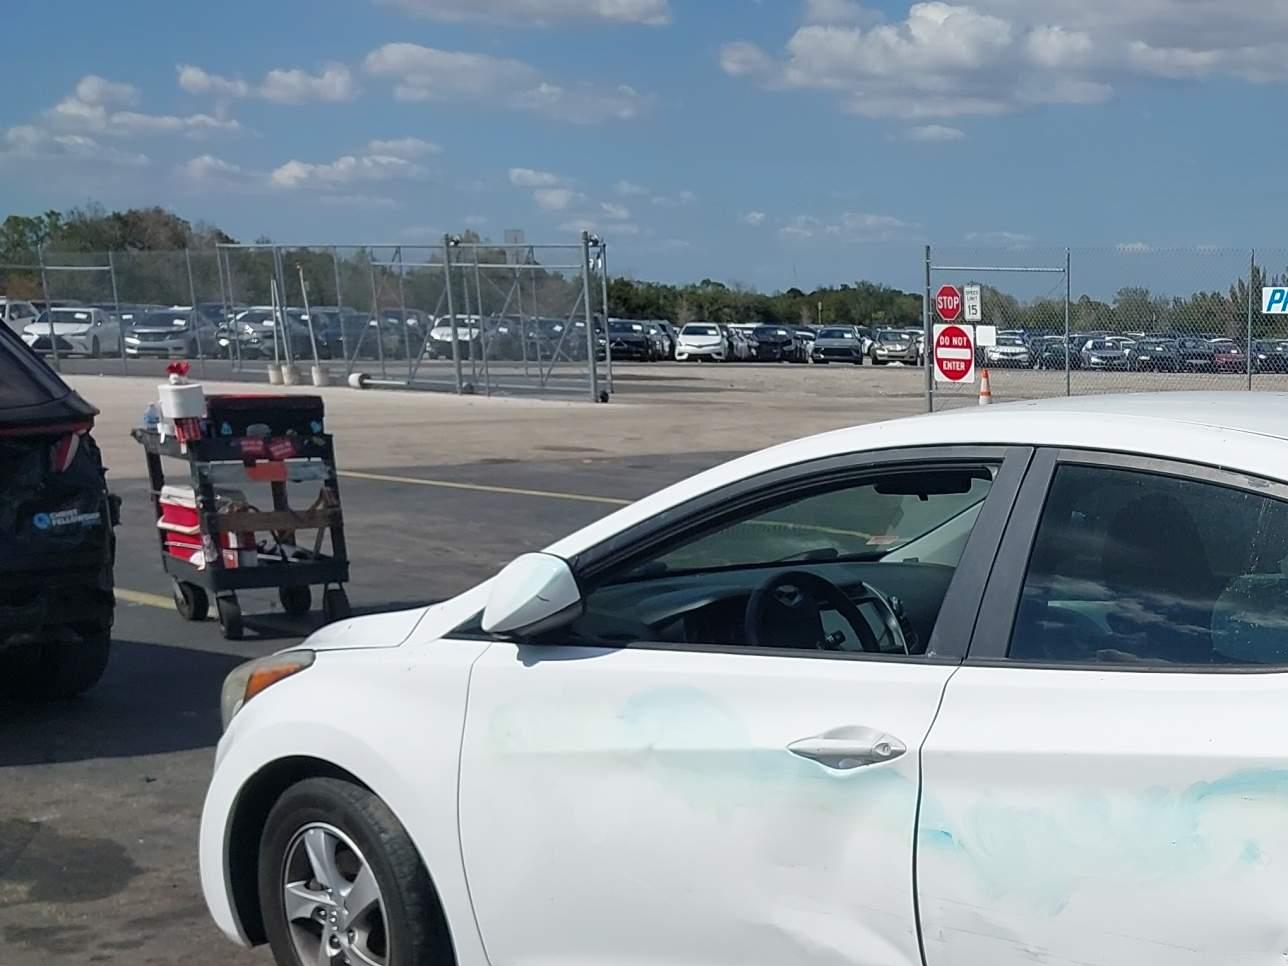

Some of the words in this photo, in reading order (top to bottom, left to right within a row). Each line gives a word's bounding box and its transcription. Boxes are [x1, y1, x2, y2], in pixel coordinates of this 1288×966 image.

[937, 296, 960, 310] STOP
[967, 304, 978, 316] 15
[939, 336, 950, 346] DO
[952, 336, 967, 347] NOT
[942, 361, 966, 371] ENTER
